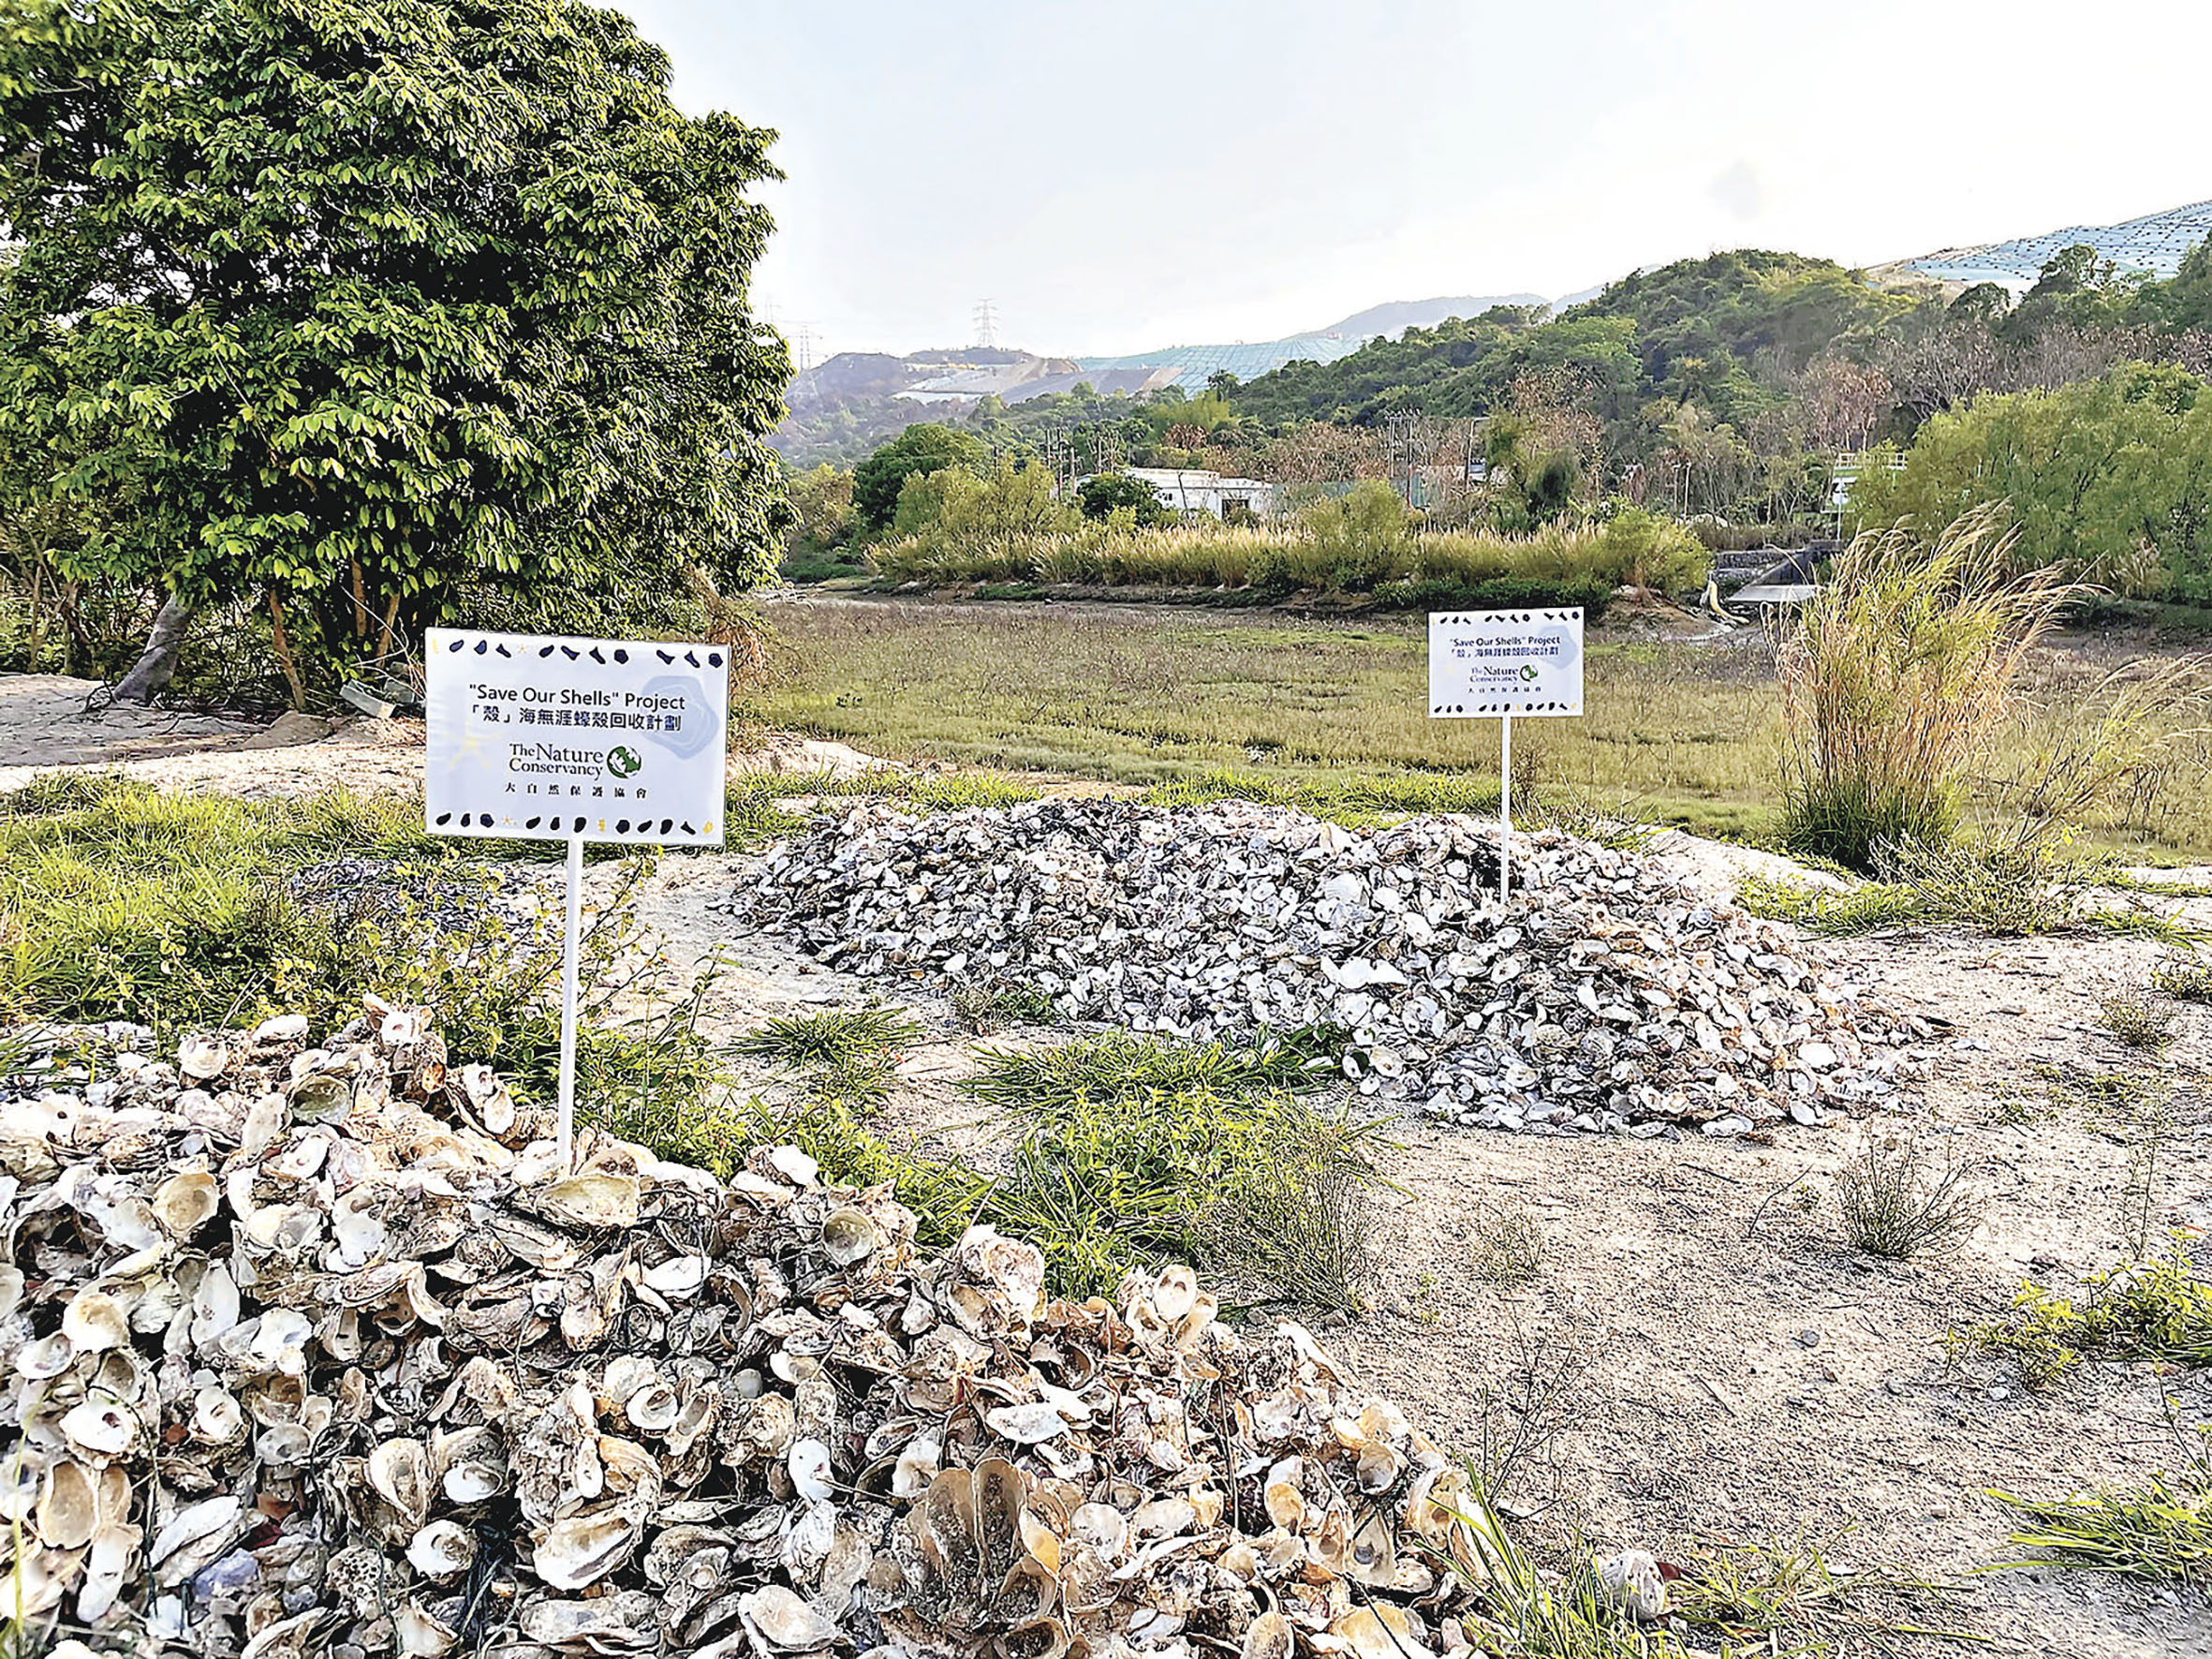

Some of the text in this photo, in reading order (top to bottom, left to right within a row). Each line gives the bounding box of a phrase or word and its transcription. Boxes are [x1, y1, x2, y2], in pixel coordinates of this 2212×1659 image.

[1476, 637, 1493, 646] Our
[1528, 636, 1561, 646] Project
[1483, 666, 1518, 675] Nature
[469, 684, 686, 711] "Save Our Shells" Project
[509, 742, 604, 764] The Nature
[509, 756, 604, 780] Conservancy
